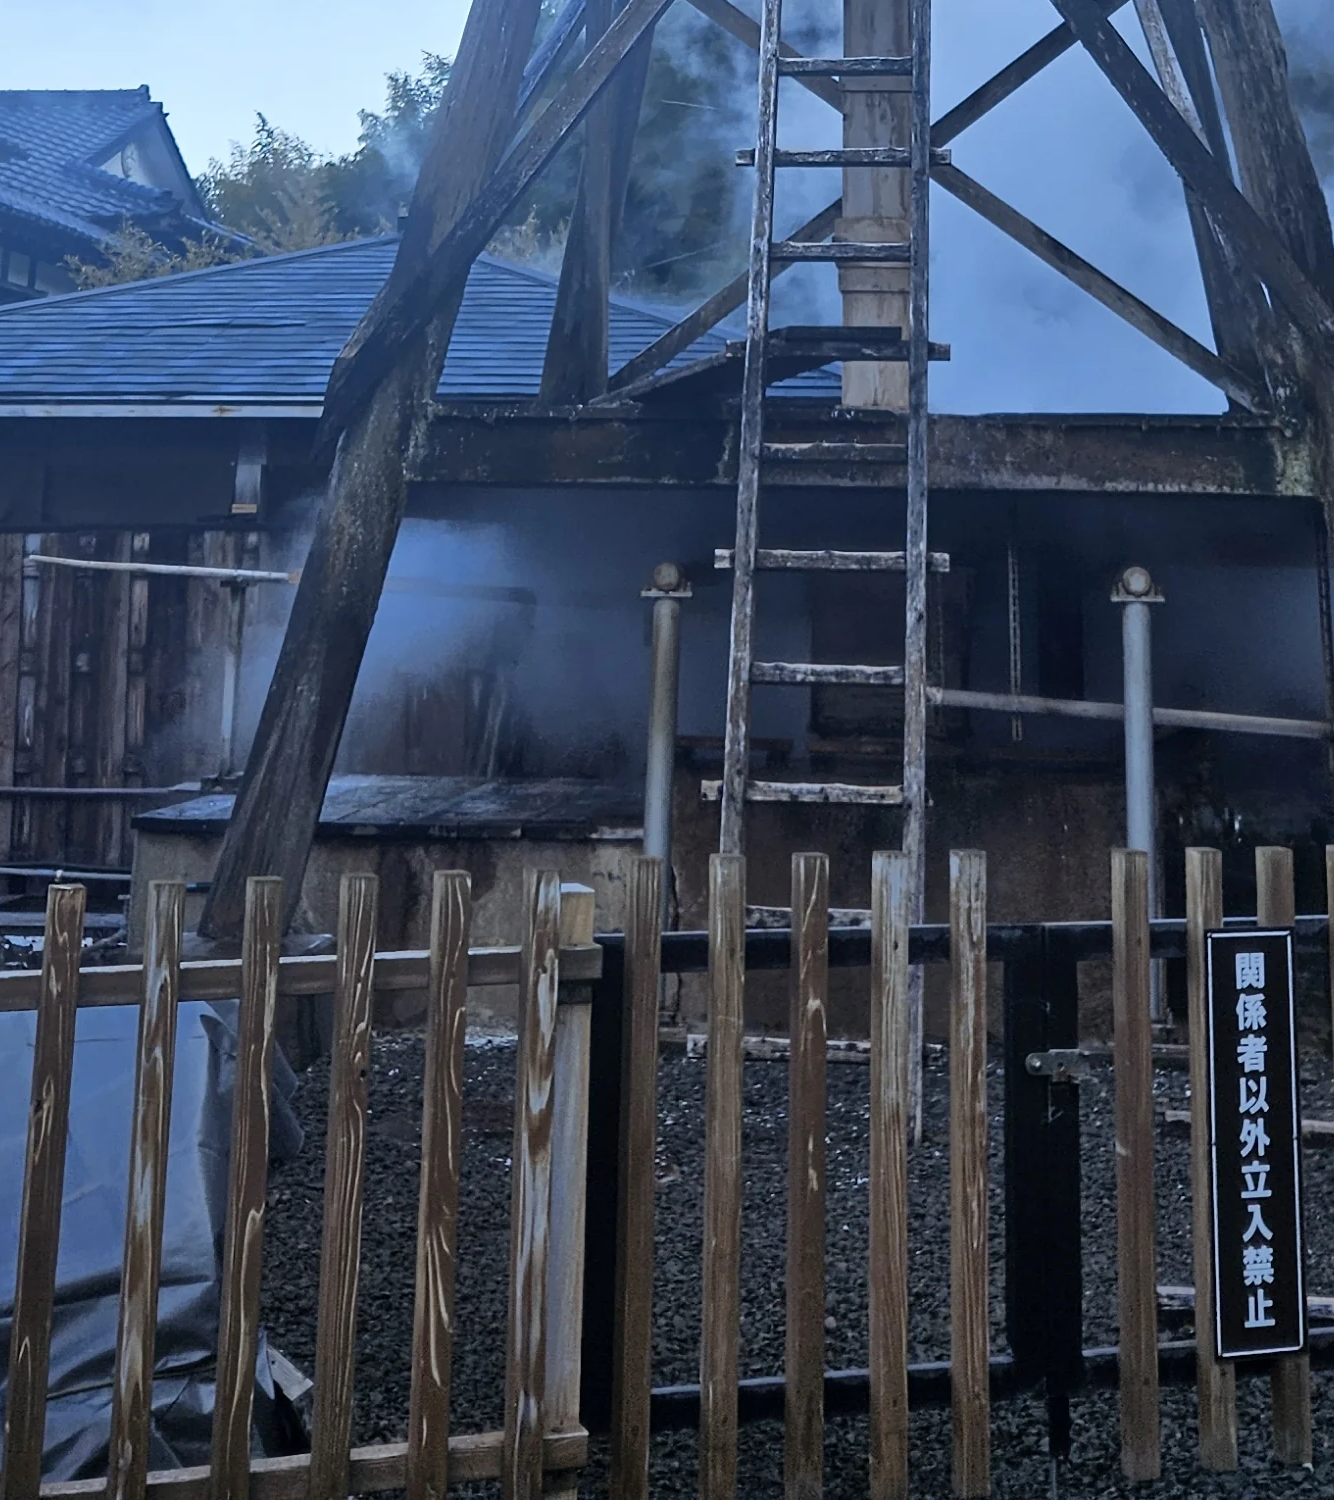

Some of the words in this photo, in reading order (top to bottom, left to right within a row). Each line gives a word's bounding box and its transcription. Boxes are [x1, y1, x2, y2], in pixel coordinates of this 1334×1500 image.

[1234, 952, 1276, 1328] 関係者以外立入禁止
